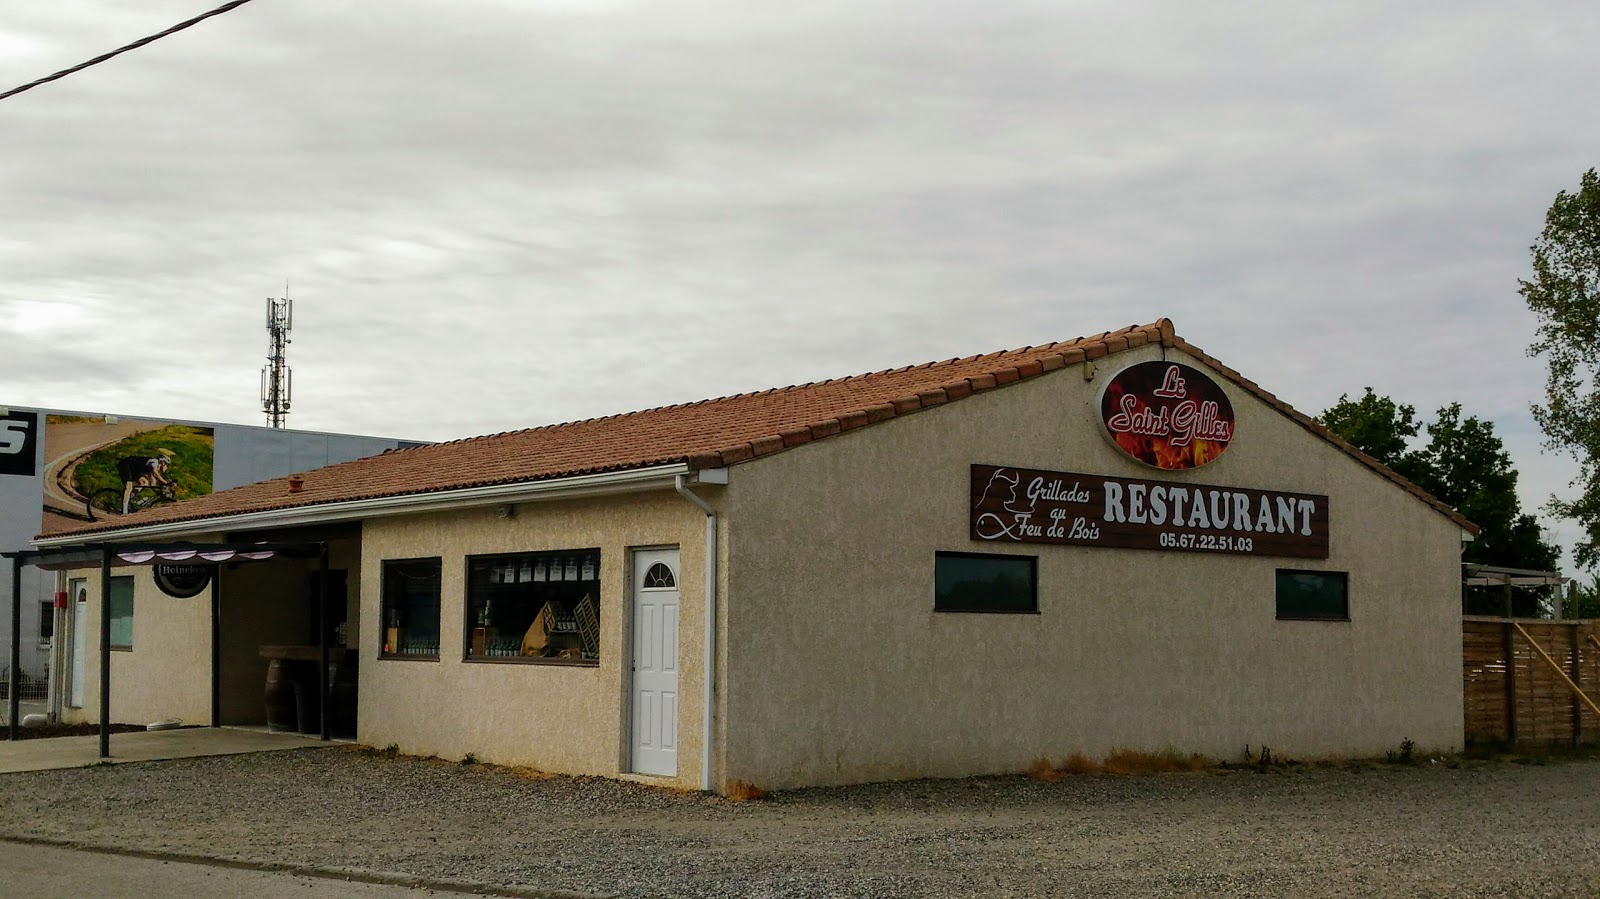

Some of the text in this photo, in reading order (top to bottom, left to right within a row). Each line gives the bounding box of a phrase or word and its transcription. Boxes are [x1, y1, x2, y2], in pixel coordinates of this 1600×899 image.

[1108, 394, 1230, 447] Saint Gilles
[1027, 476, 1091, 504] Grillades
[1050, 506, 1067, 521] au
[1103, 481, 1316, 536] RESTAURANT
[1015, 513, 1100, 540] Feu de Bois
[1159, 532, 1254, 552] 05.67.22.51.03
[162, 565, 206, 575] Heineken
